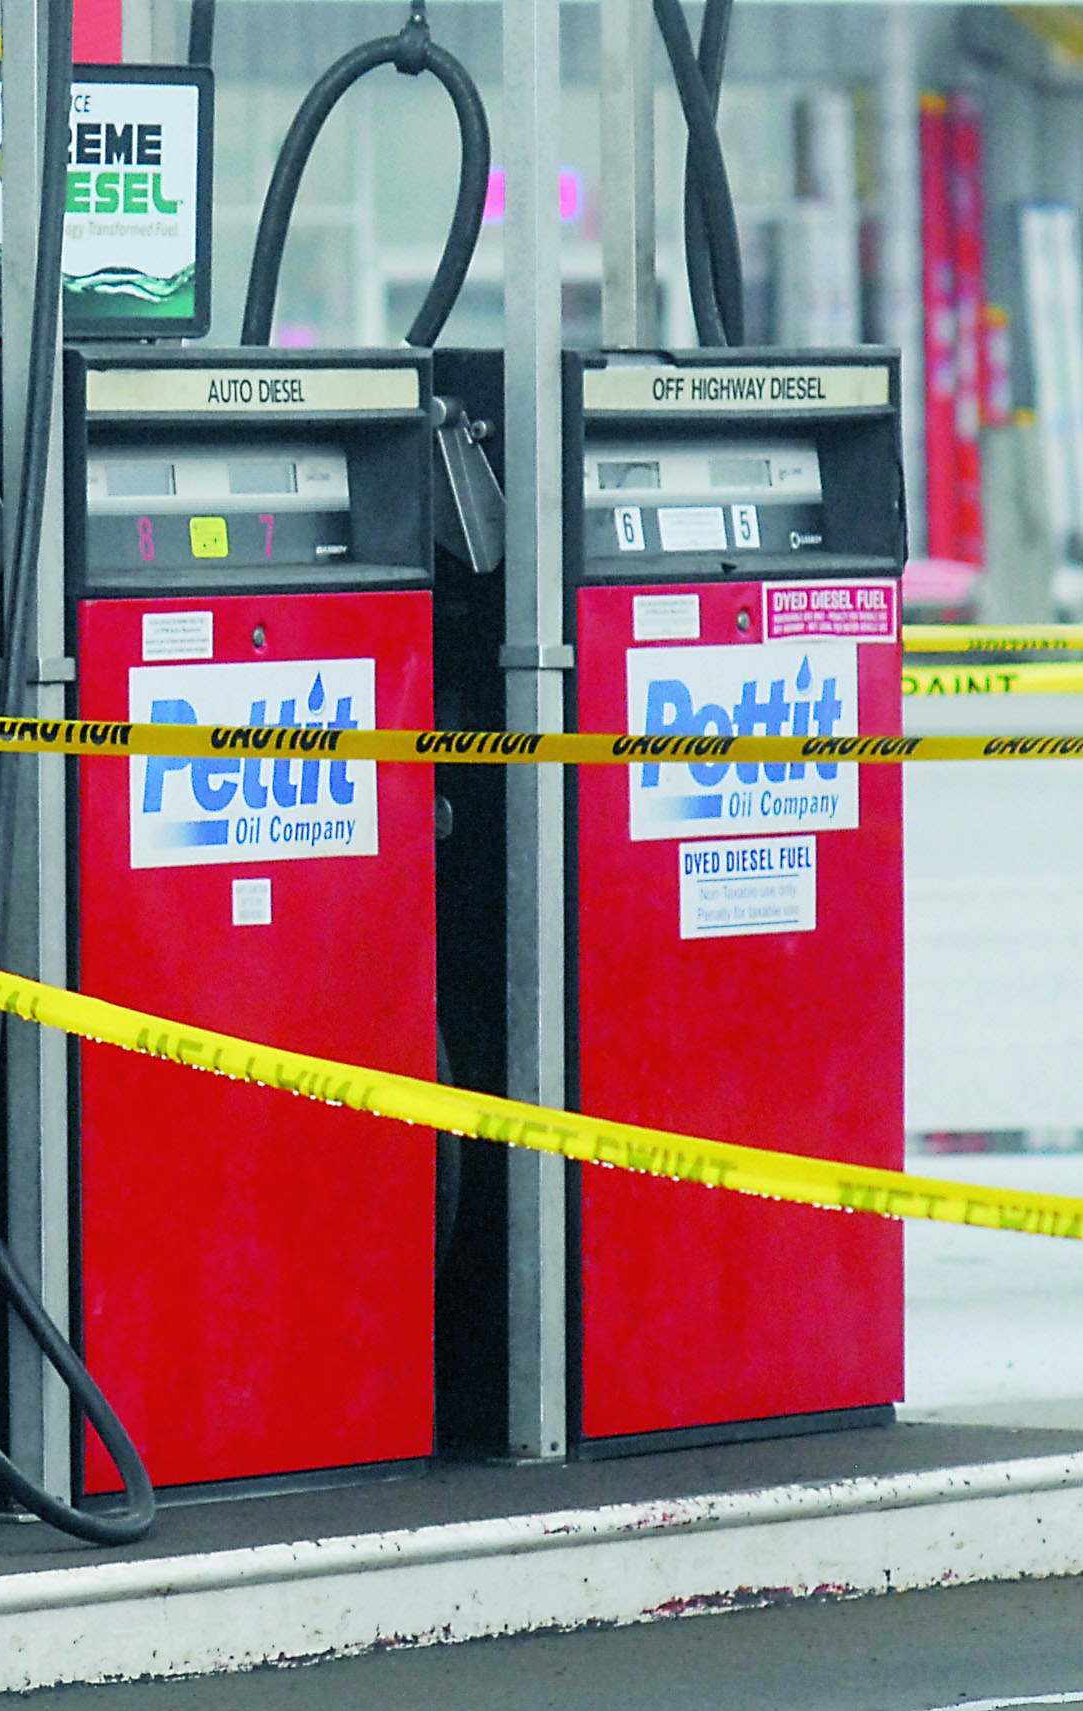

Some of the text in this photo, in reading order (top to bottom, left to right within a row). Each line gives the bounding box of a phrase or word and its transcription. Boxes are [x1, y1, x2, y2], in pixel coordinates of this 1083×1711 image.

[66, 171, 178, 214] ESEL
[208, 379, 305, 403] AUTO DIESEL
[652, 376, 826, 401] OFF HIGHWAY DIESEL
[137, 516, 155, 561] 8
[258, 514, 274, 558] 7
[623, 512, 635, 543] 6
[739, 510, 751, 541] 5
[773, 589, 888, 611] DYED DIESEL FUEL
[142, 672, 359, 813] Pettit
[729, 790, 839, 820] Oil Company
[235, 815, 356, 847] Oil Company
[684, 846, 812, 875] DYED DIESEL FUEL
